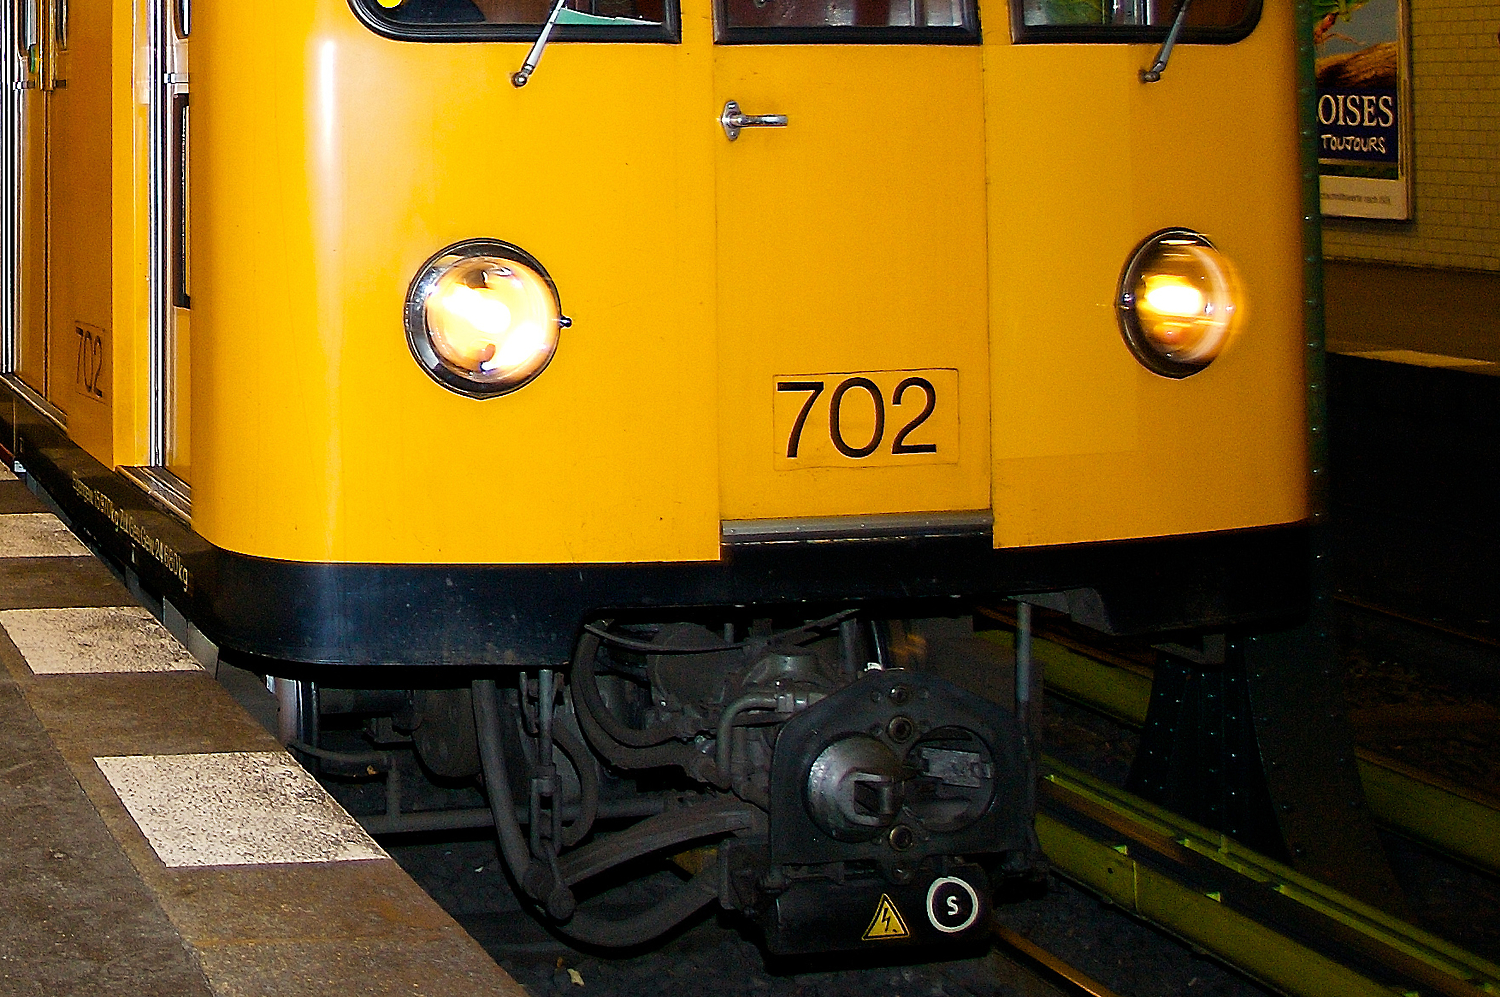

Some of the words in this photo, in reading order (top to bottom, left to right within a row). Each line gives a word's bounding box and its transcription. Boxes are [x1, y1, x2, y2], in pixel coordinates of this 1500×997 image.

[1316, 94, 1393, 128] OISES
[1320, 134, 1386, 154] TOUJOURS
[75, 326, 102, 398] 702
[777, 376, 937, 459] 702
[946, 895, 959, 916] S
